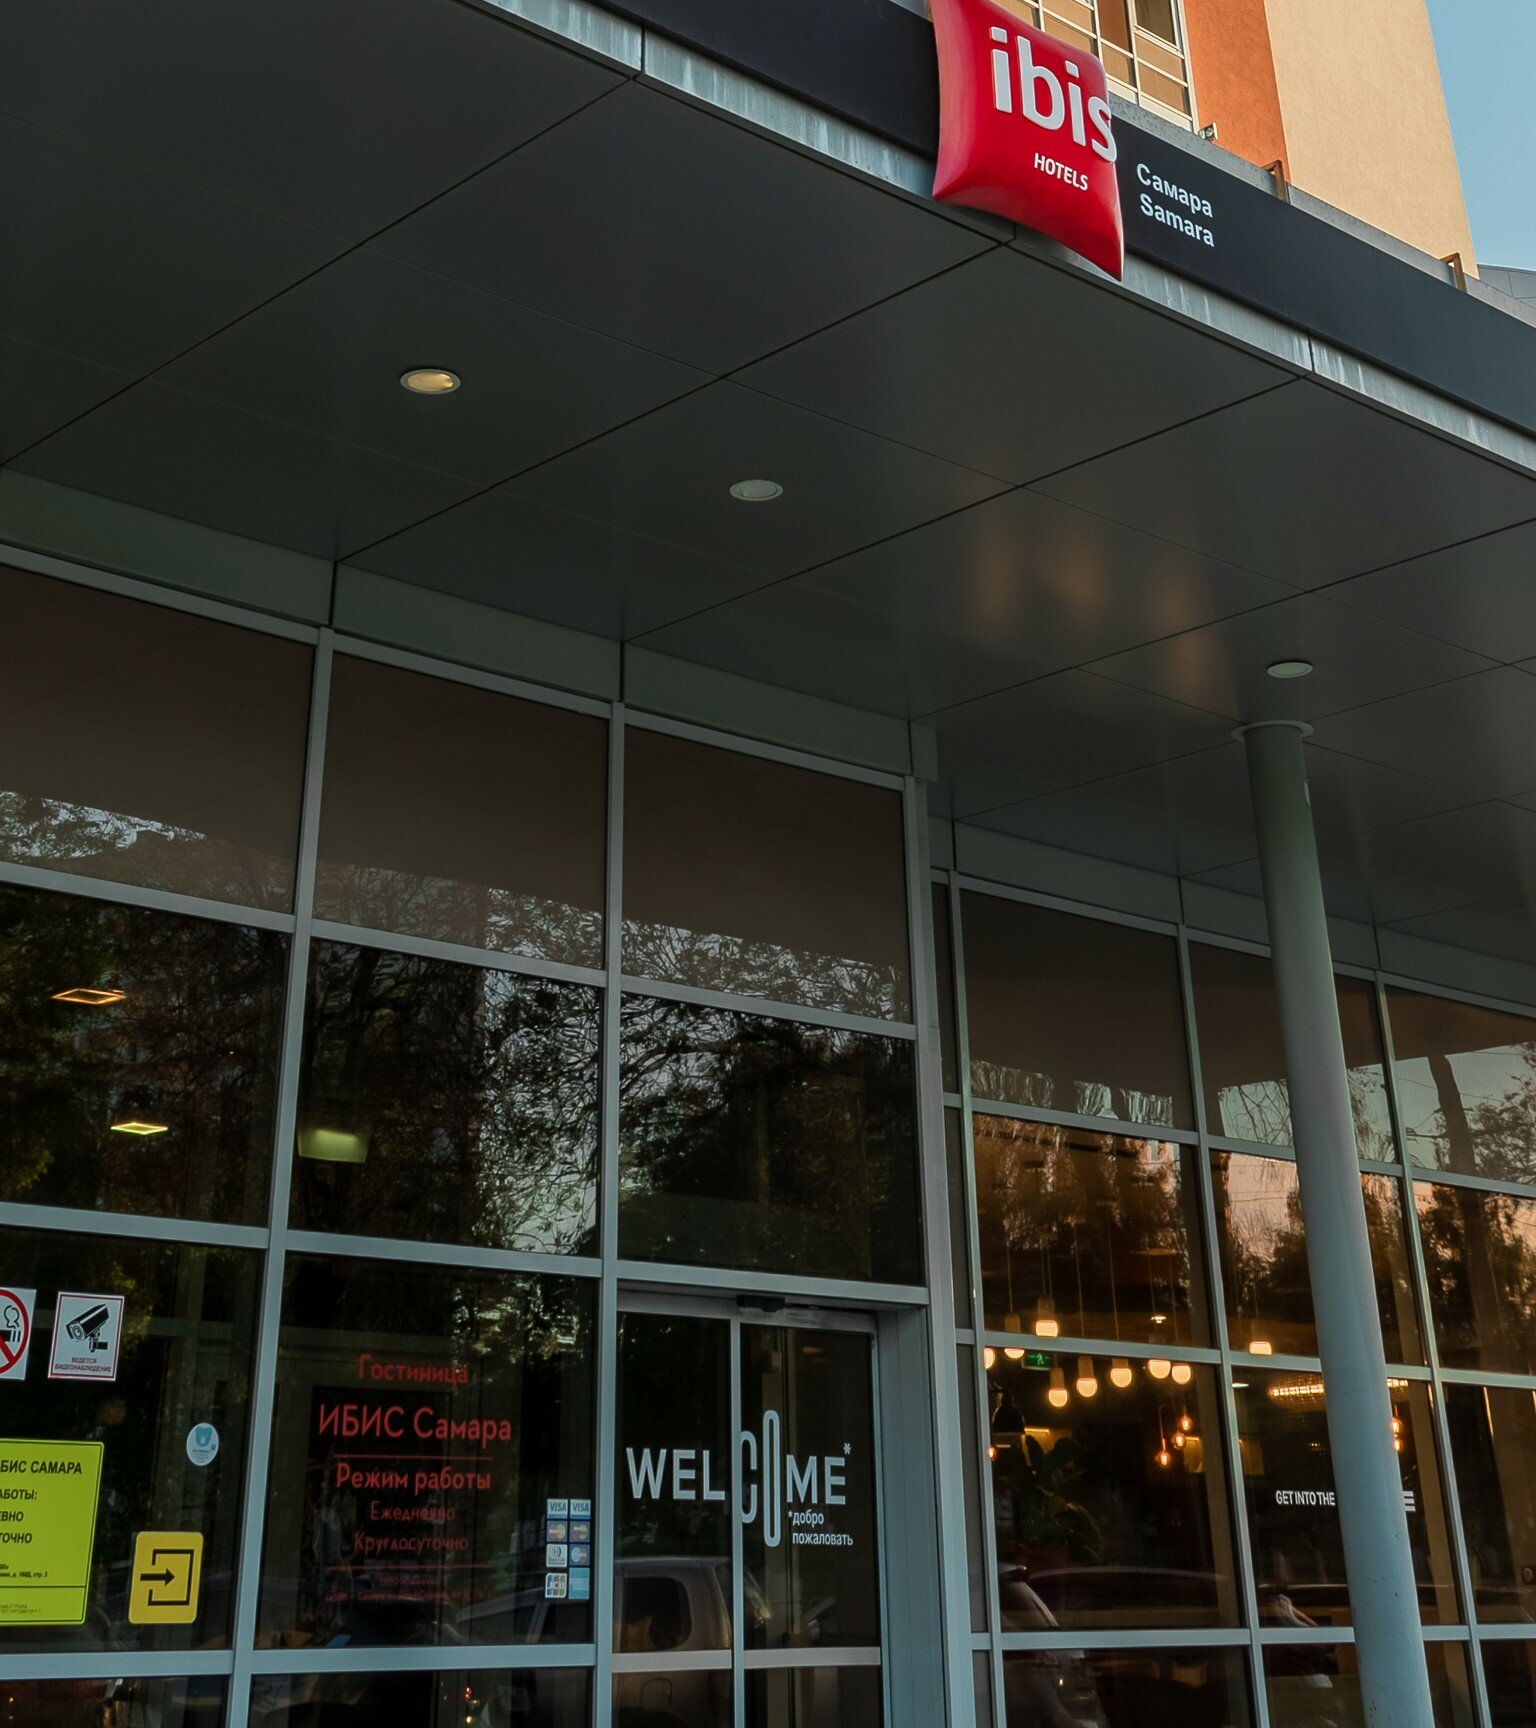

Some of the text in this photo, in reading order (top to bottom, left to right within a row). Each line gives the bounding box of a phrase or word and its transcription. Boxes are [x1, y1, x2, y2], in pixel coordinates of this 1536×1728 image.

[989, 25, 1118, 164] ibis
[1033, 152, 1089, 192] HOTELS
[1136, 162, 1214, 219] Самара
[1139, 192, 1216, 248] Samara
[358, 1353, 469, 1386] Гостиница
[319, 1404, 512, 1449] ИБИС Самара
[30, 1460, 82, 1475] САМАРА
[336, 1462, 491, 1496] Режим работы
[549, 1501, 566, 1512] VISA
[572, 1502, 588, 1512] VISA
[1275, 1490, 1336, 1506] GET INTO THE
[792, 1532, 854, 1546] пожаловать
